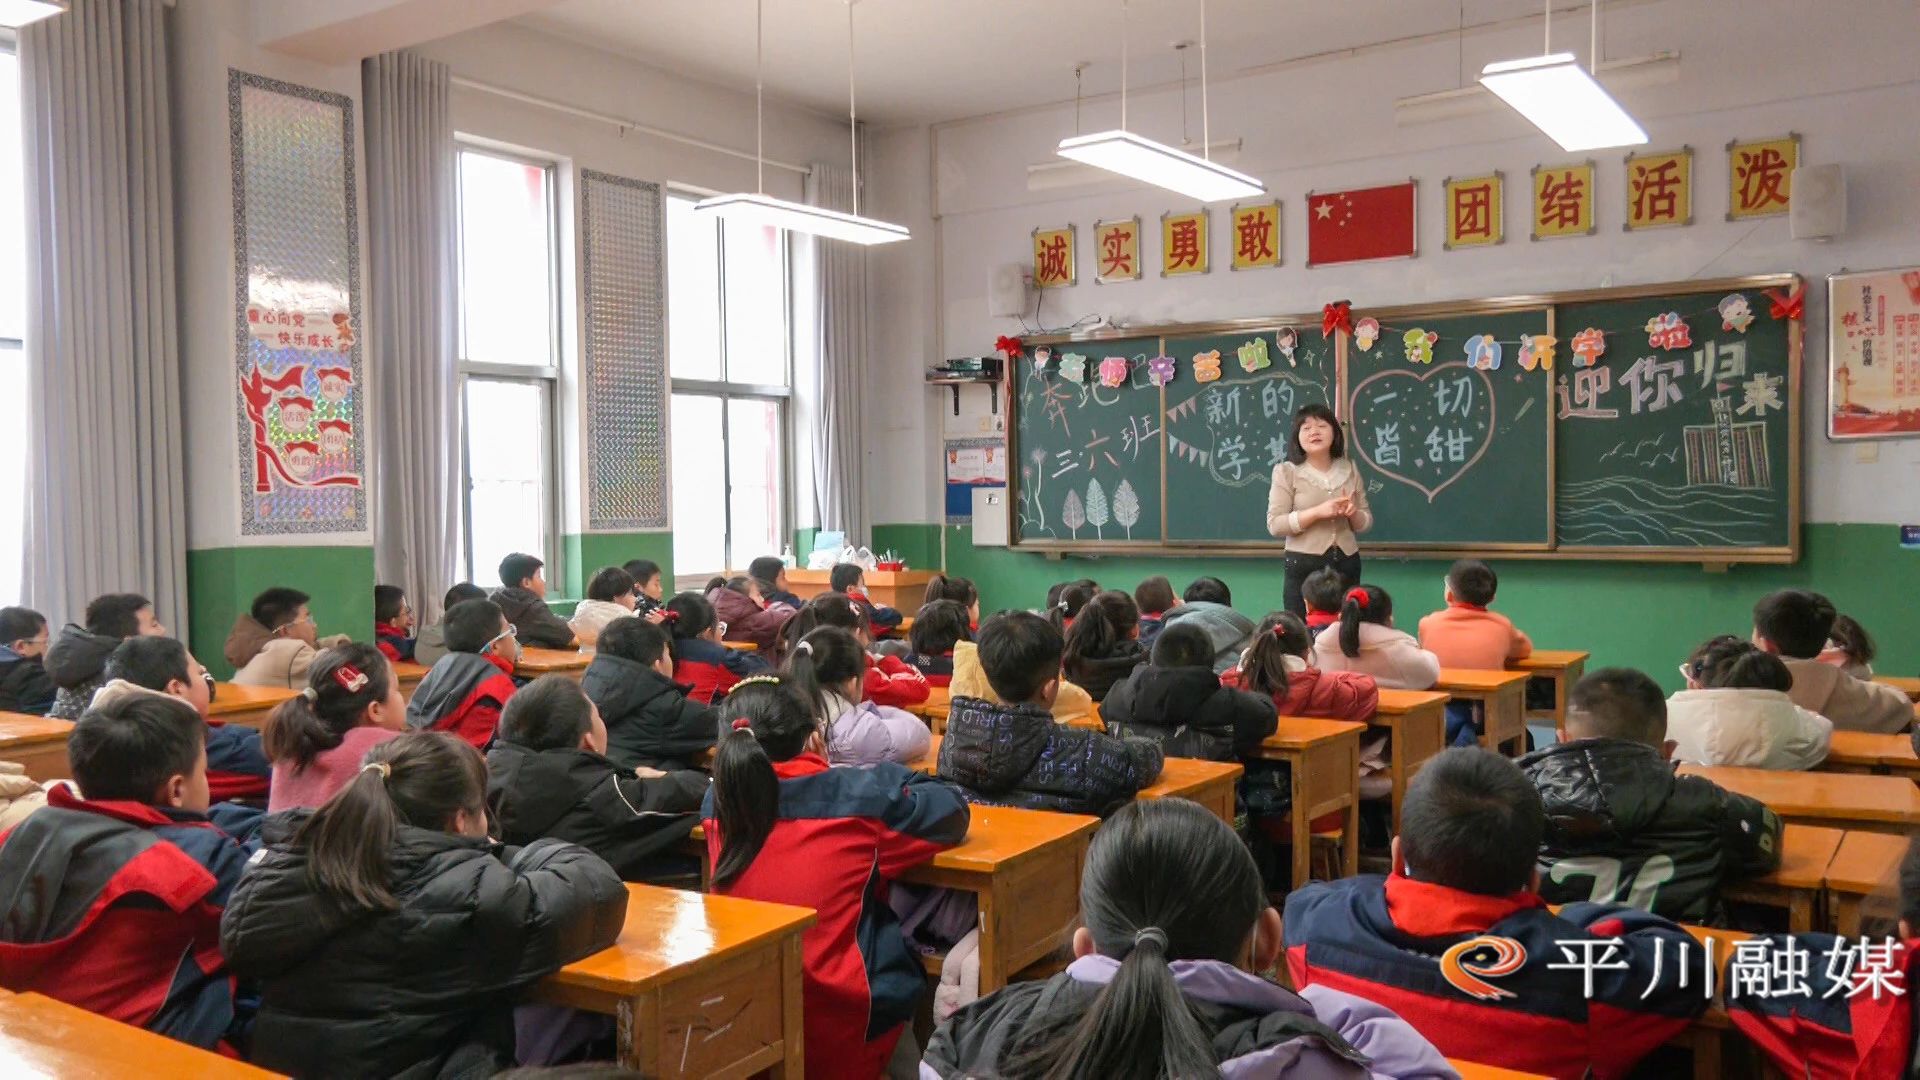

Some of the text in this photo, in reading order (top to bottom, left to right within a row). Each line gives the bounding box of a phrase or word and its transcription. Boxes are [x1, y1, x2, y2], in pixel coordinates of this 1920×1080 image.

[1454, 148, 1790, 240] 团结活泼
[1037, 213, 1273, 282] 诚实勇敢
[248, 309, 305, 328] 童心向党
[278, 331, 333, 348] 快乐成长
[1373, 376, 1473, 417] 一切
[1556, 340, 1784, 420] 迎你归来
[1206, 380, 1294, 426] 新的
[1374, 421, 1473, 466] 皆甜
